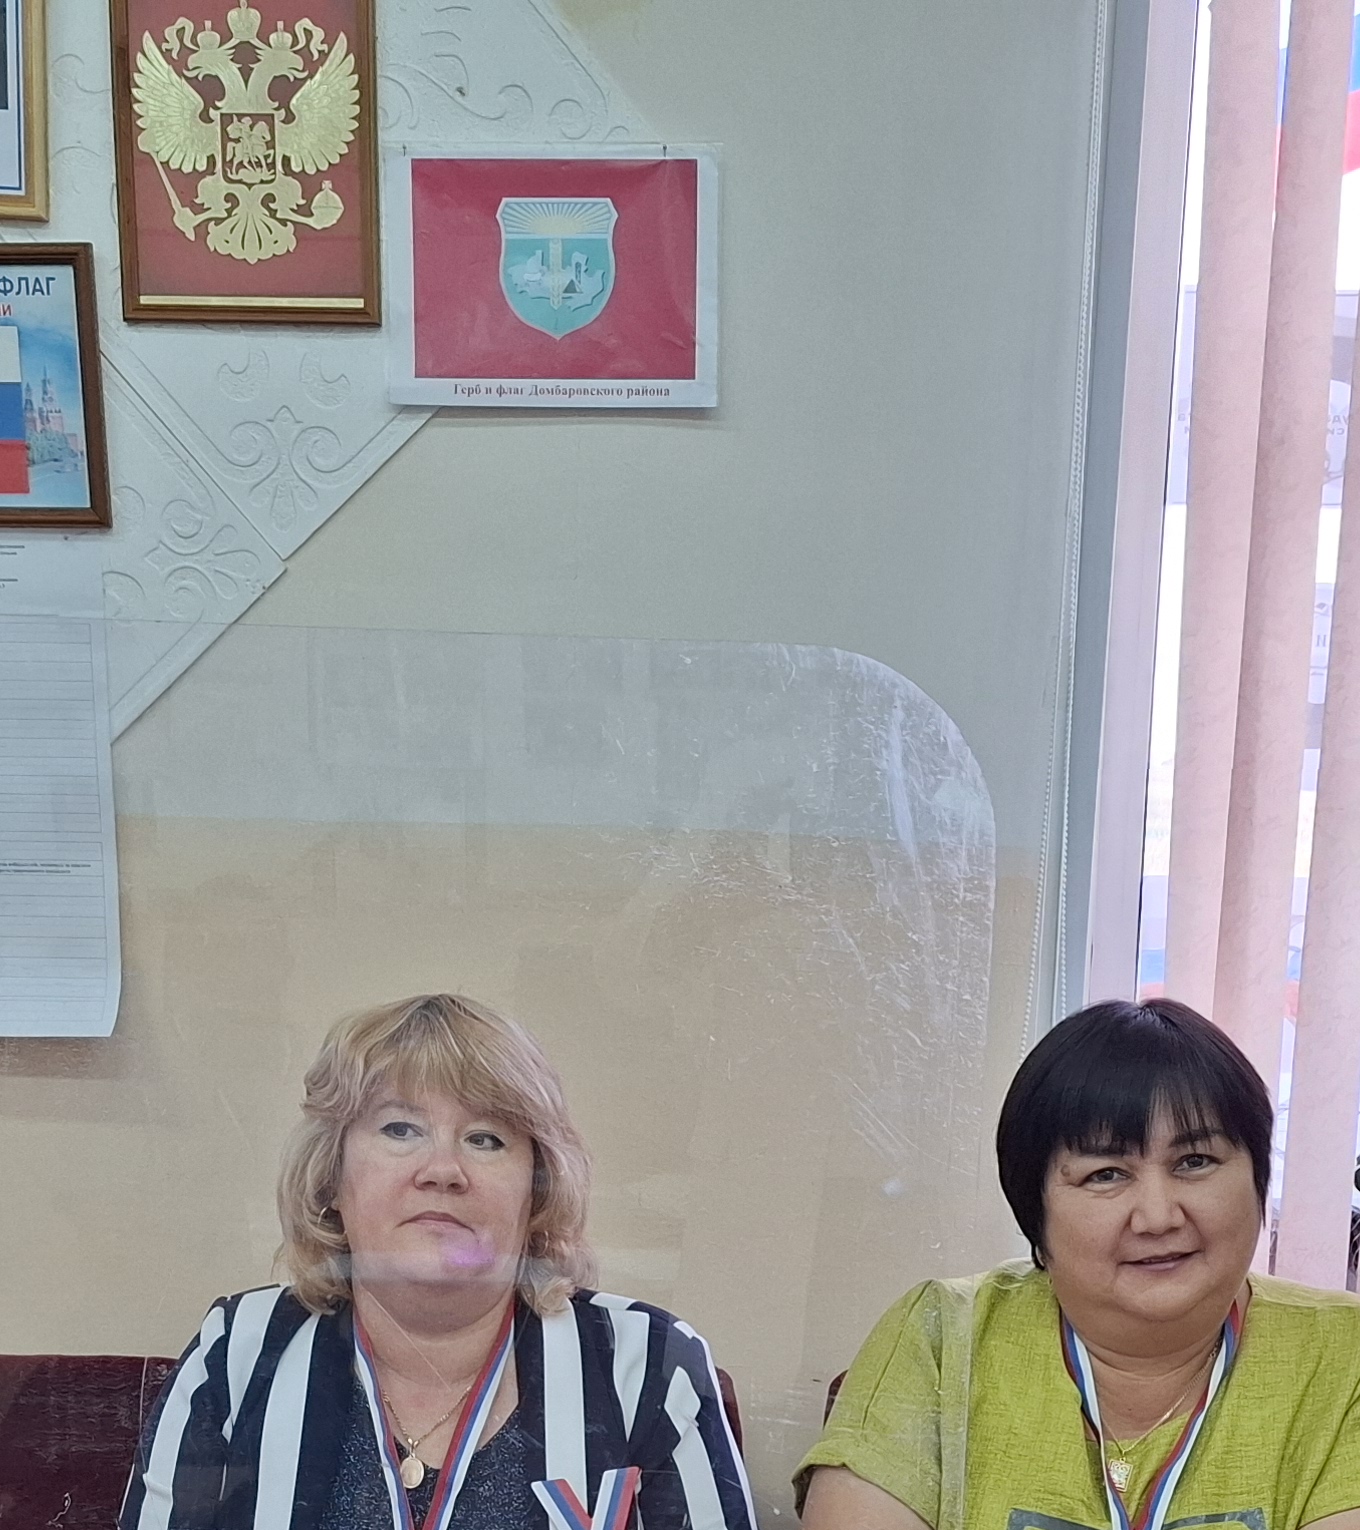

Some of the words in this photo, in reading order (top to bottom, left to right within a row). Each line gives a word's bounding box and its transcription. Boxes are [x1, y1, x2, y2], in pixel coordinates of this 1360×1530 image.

[453, 383, 481, 397] Герб
[495, 382, 525, 399] флаг
[626, 385, 671, 399] района
